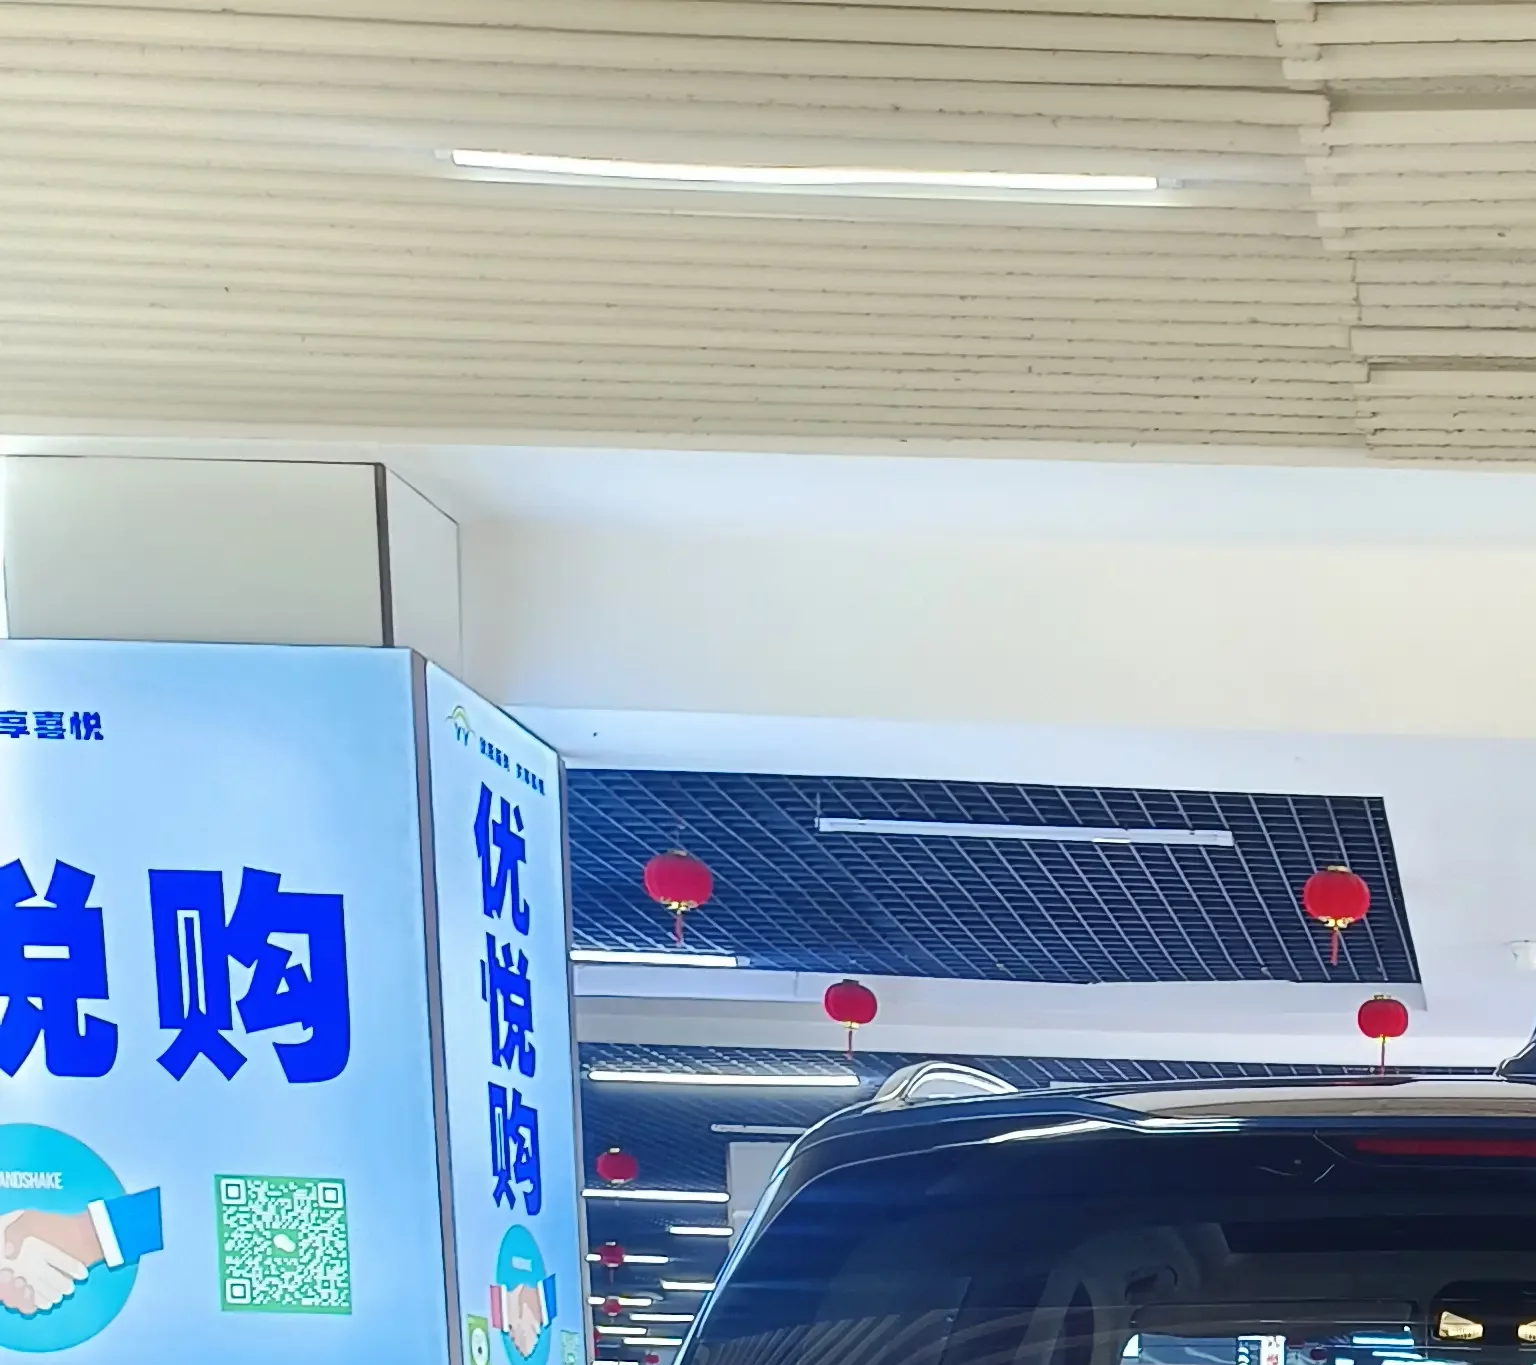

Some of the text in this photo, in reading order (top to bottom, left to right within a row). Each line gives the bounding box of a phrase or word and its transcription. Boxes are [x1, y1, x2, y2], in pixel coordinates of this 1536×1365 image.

[0, 858, 351, 1084] 悦购
[473, 780, 542, 1217] 优悦购
